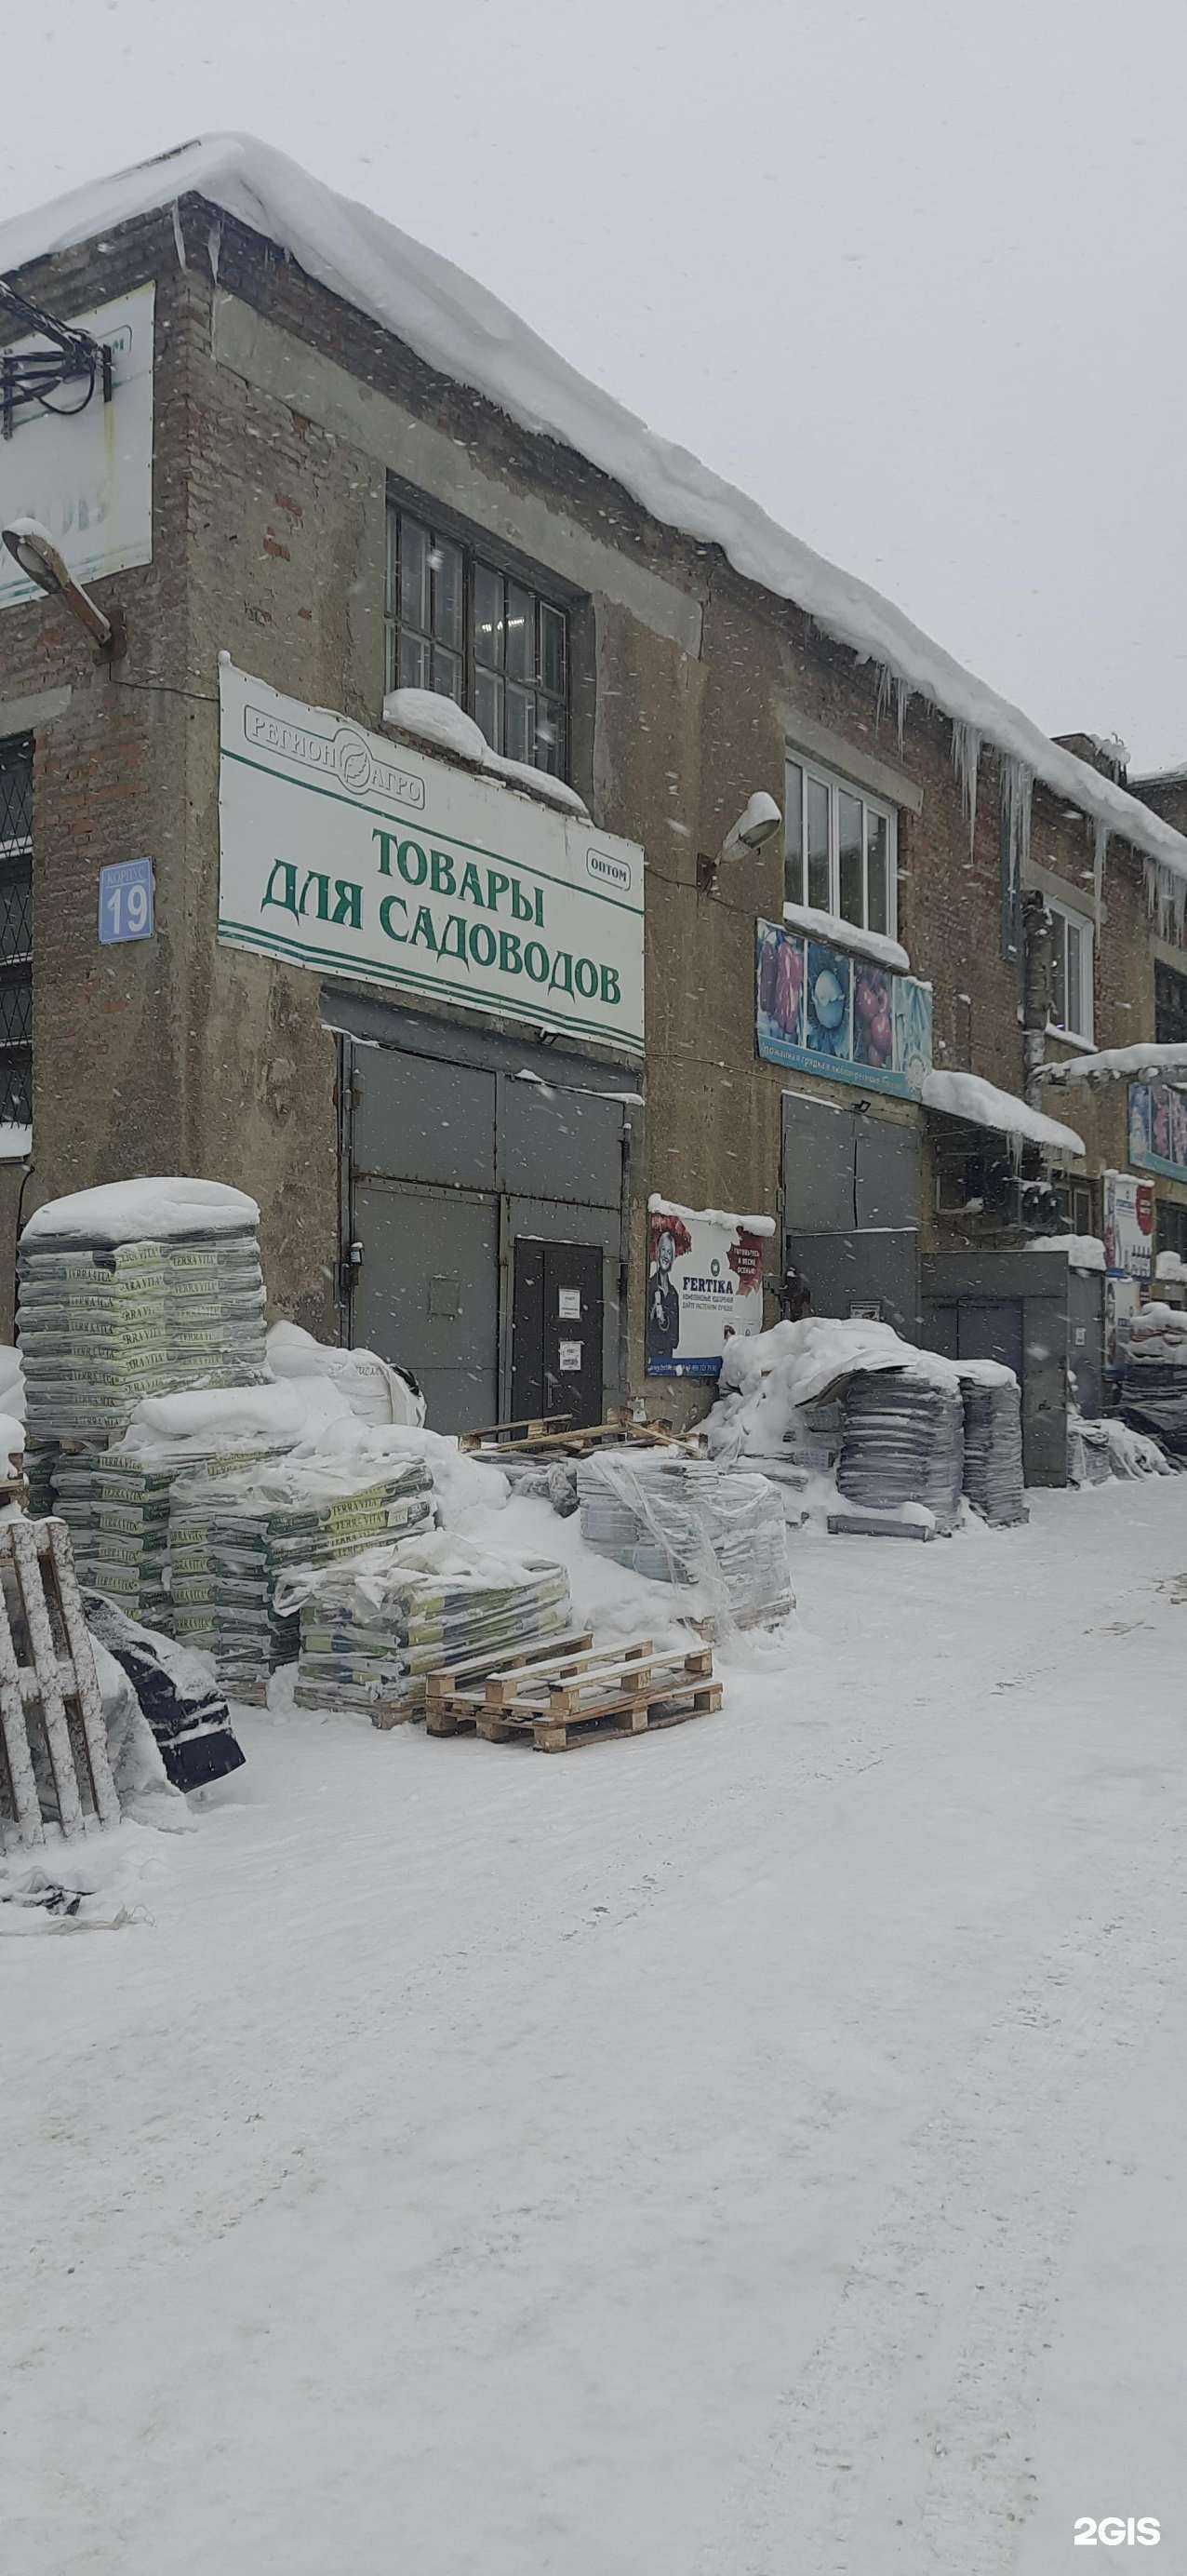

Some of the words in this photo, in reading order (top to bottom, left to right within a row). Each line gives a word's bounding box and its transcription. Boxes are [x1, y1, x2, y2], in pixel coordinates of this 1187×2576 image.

[252, 717, 337, 768] РЕГИОН
[372, 769, 420, 801] АГРО
[372, 828, 545, 928] ТОВАРЫ
[591, 857, 627, 882] ОПТОМ
[107, 884, 147, 934] 19
[260, 858, 364, 930] ДЛЯ
[379, 895, 621, 1004] САДОВОДОВ
[683, 1276, 733, 1295] FERTIKA
